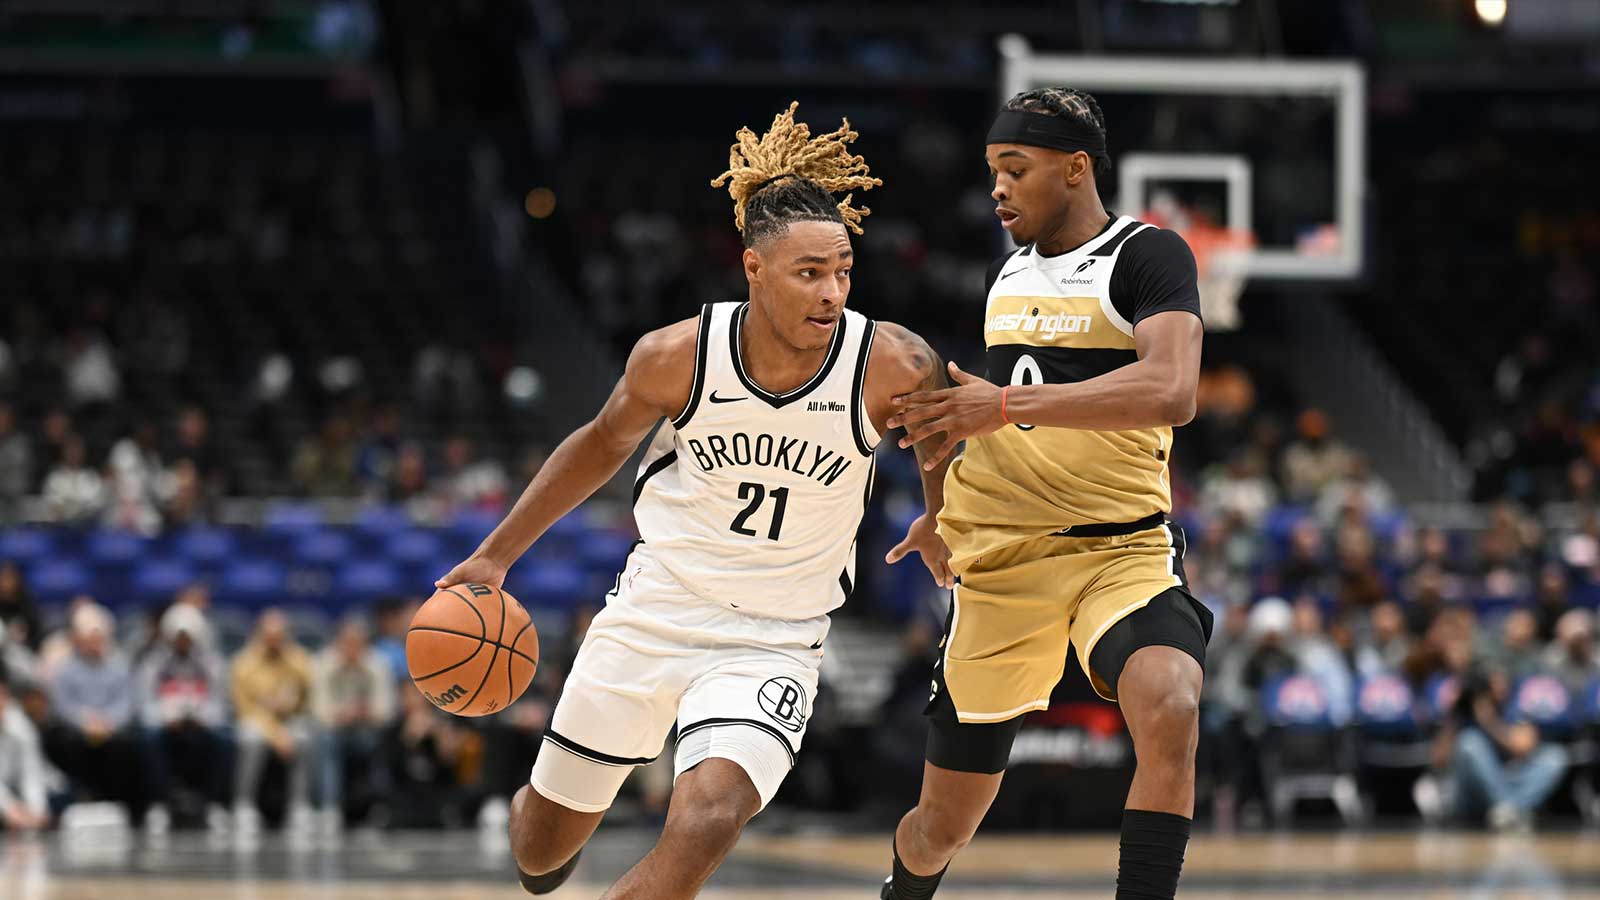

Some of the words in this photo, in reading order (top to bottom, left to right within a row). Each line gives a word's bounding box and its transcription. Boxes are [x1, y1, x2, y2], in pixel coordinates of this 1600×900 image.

[807, 401, 819, 412] All
[819, 401, 827, 412] In
[688, 432, 852, 487] BROOKLYN
[730, 481, 789, 541] 21
[774, 684, 799, 721] B
